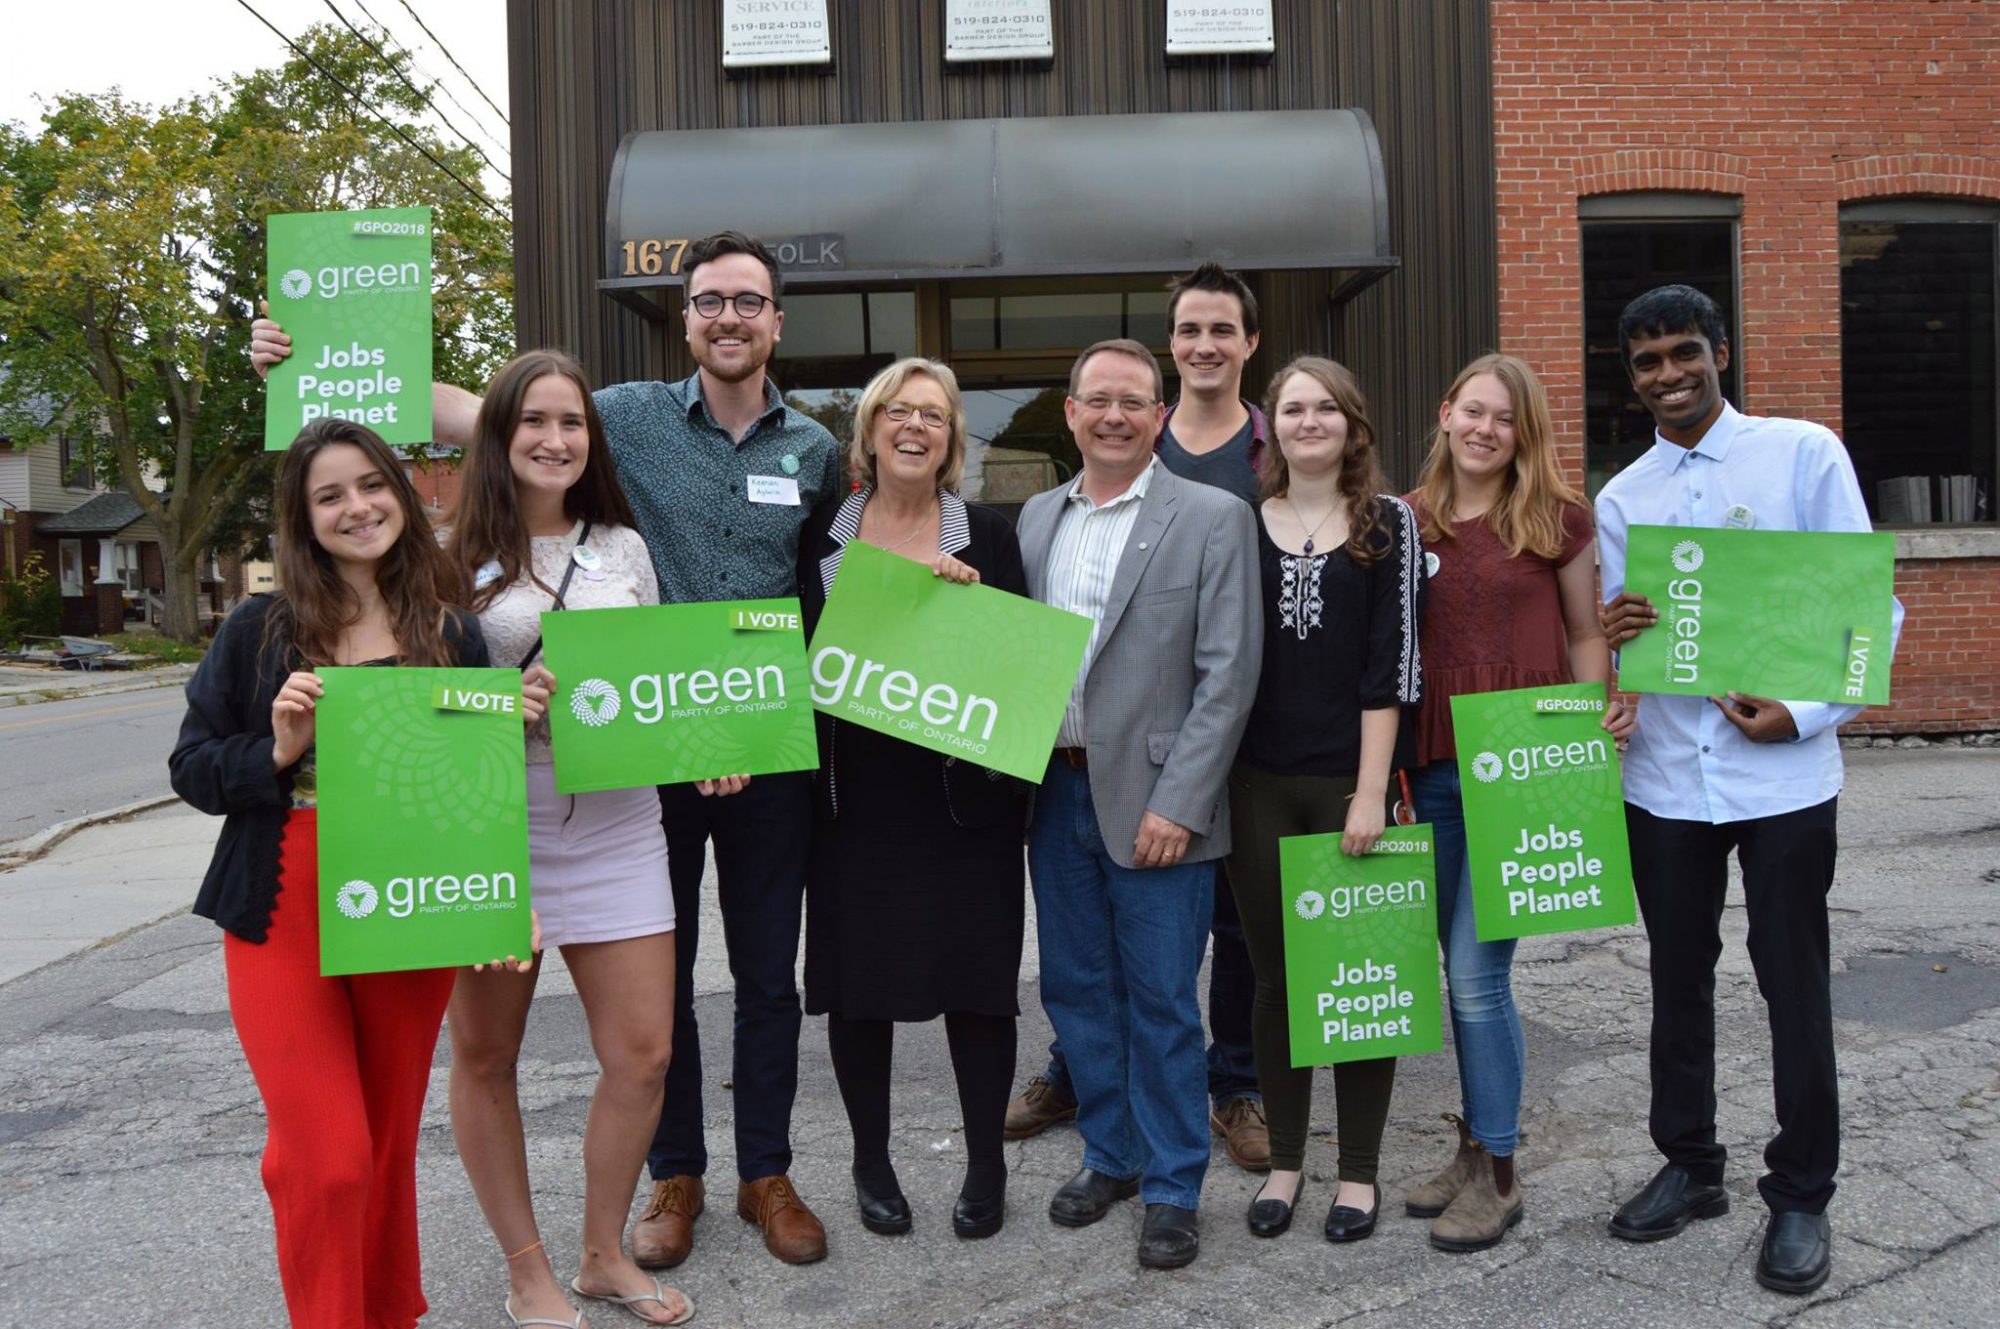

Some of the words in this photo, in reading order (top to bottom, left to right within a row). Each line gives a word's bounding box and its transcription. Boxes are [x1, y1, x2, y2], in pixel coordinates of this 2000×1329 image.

[736, 0, 815, 14] SERVICE
[353, 221, 425, 235] #GPO2018
[622, 239, 688, 276] 167
[318, 262, 419, 298] green
[314, 341, 386, 369] Jobs
[298, 369, 402, 402] People
[738, 612, 744, 626] I
[749, 612, 799, 629] VOTE
[1668, 579, 1702, 684] green
[1845, 648, 1870, 697] VOTE
[442, 689, 449, 705] I
[456, 690, 515, 712] VOTE
[630, 664, 785, 724] green
[809, 646, 998, 740] green
[1536, 699, 1604, 711] #GPO2018
[671, 706, 711, 719] PARTY
[715, 705, 731, 716] OF
[735, 701, 788, 713] ONTARIO
[847, 700, 895, 725] PARTY
[898, 718, 919, 731] OF
[923, 726, 987, 755] ONTARIO
[1508, 739, 1607, 781] green
[1514, 823, 1583, 854] Jobs
[1501, 851, 1603, 887] People
[386, 871, 517, 918] green
[419, 905, 451, 914] PARTY
[455, 904, 469, 912] OF
[472, 901, 517, 911] ONTARIO
[1330, 879, 1426, 918] green
[1509, 884, 1602, 916] Planet
[1330, 958, 1398, 987] Jobs
[1317, 984, 1414, 1017] People
[1323, 1015, 1412, 1044] Planet
